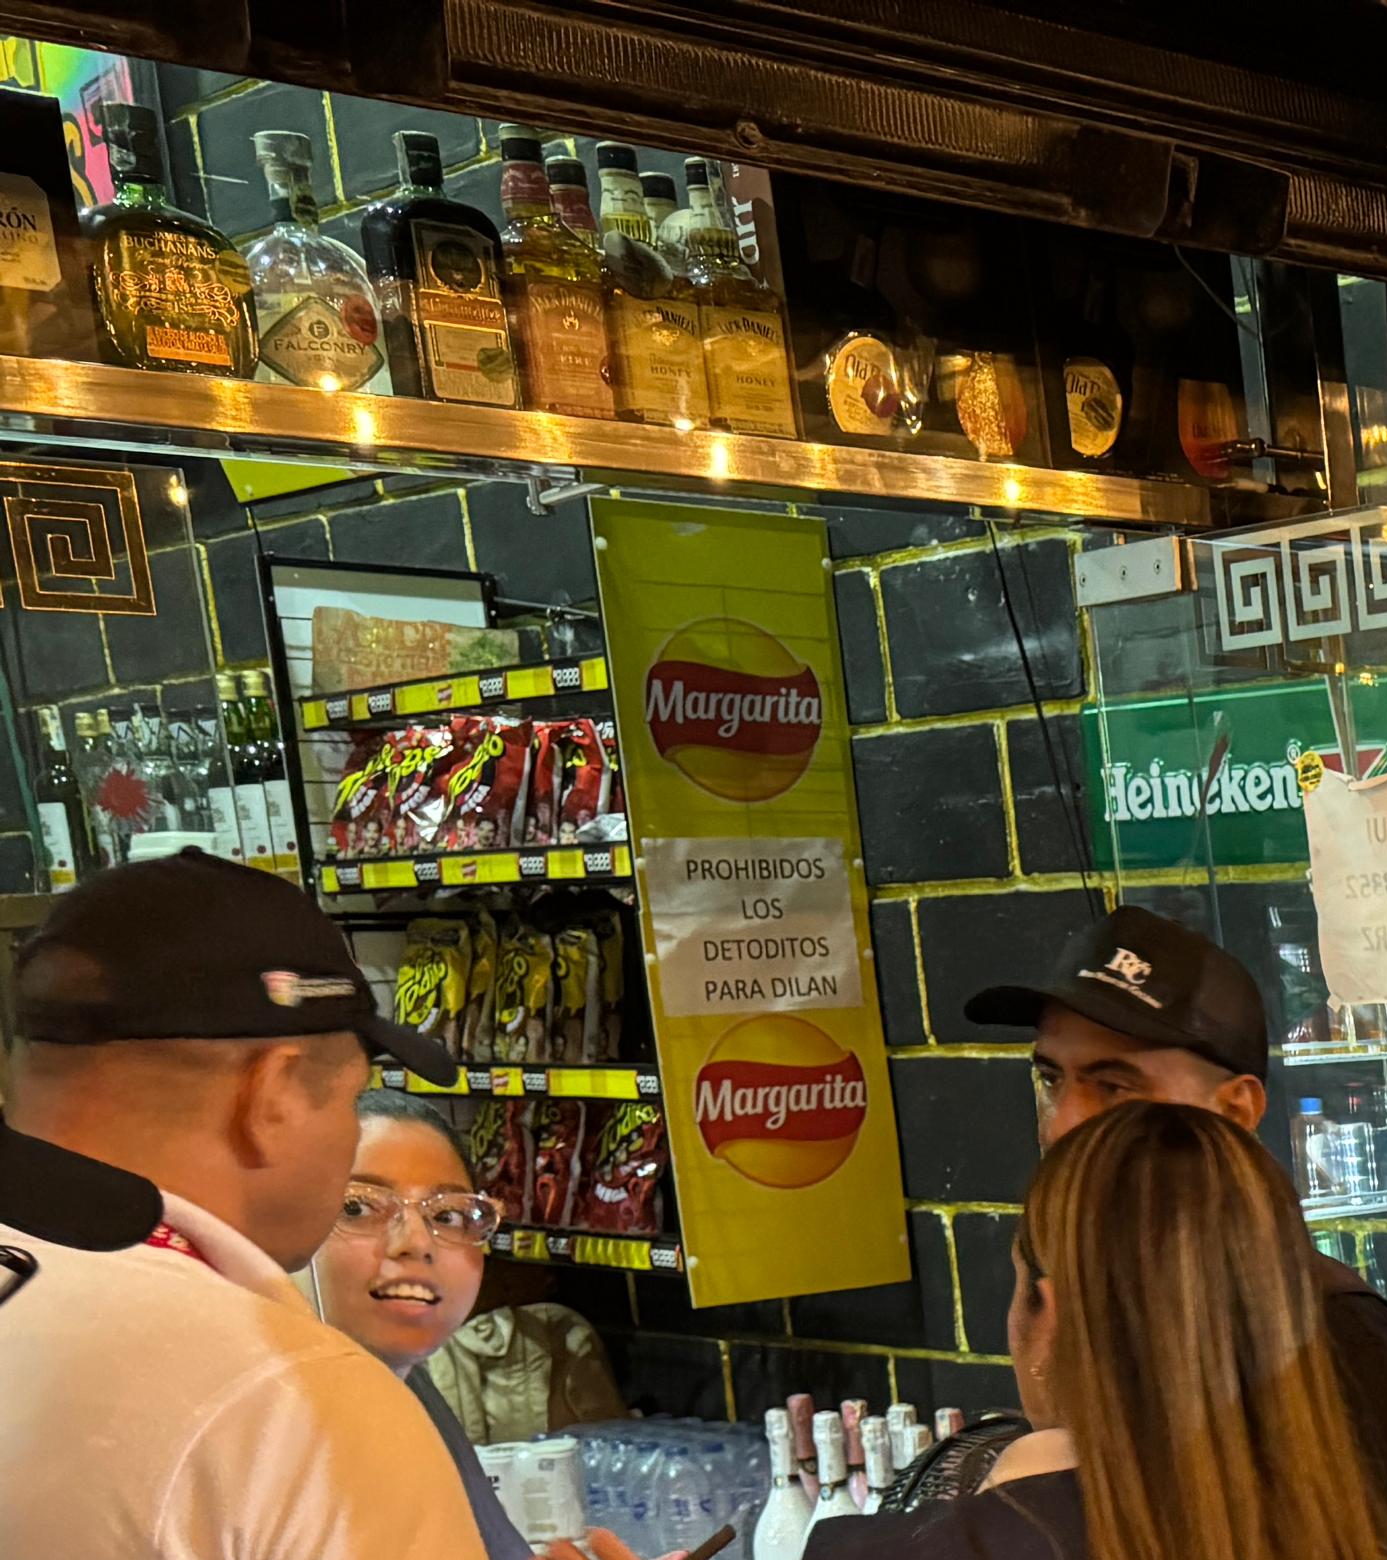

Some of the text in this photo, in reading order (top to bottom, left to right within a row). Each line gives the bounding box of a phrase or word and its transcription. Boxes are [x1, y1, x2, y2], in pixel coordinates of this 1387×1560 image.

[273, 339, 367, 356] FALCONRY
[645, 678, 822, 739] Margarita
[1101, 757, 1302, 822] Heineken
[686, 858, 825, 880] PROHIBIDOS
[741, 898, 784, 920] LOS
[703, 936, 830, 961] DETODITOS
[705, 976, 838, 1002] PARA DILAN
[696, 1074, 869, 1131] Margarita
